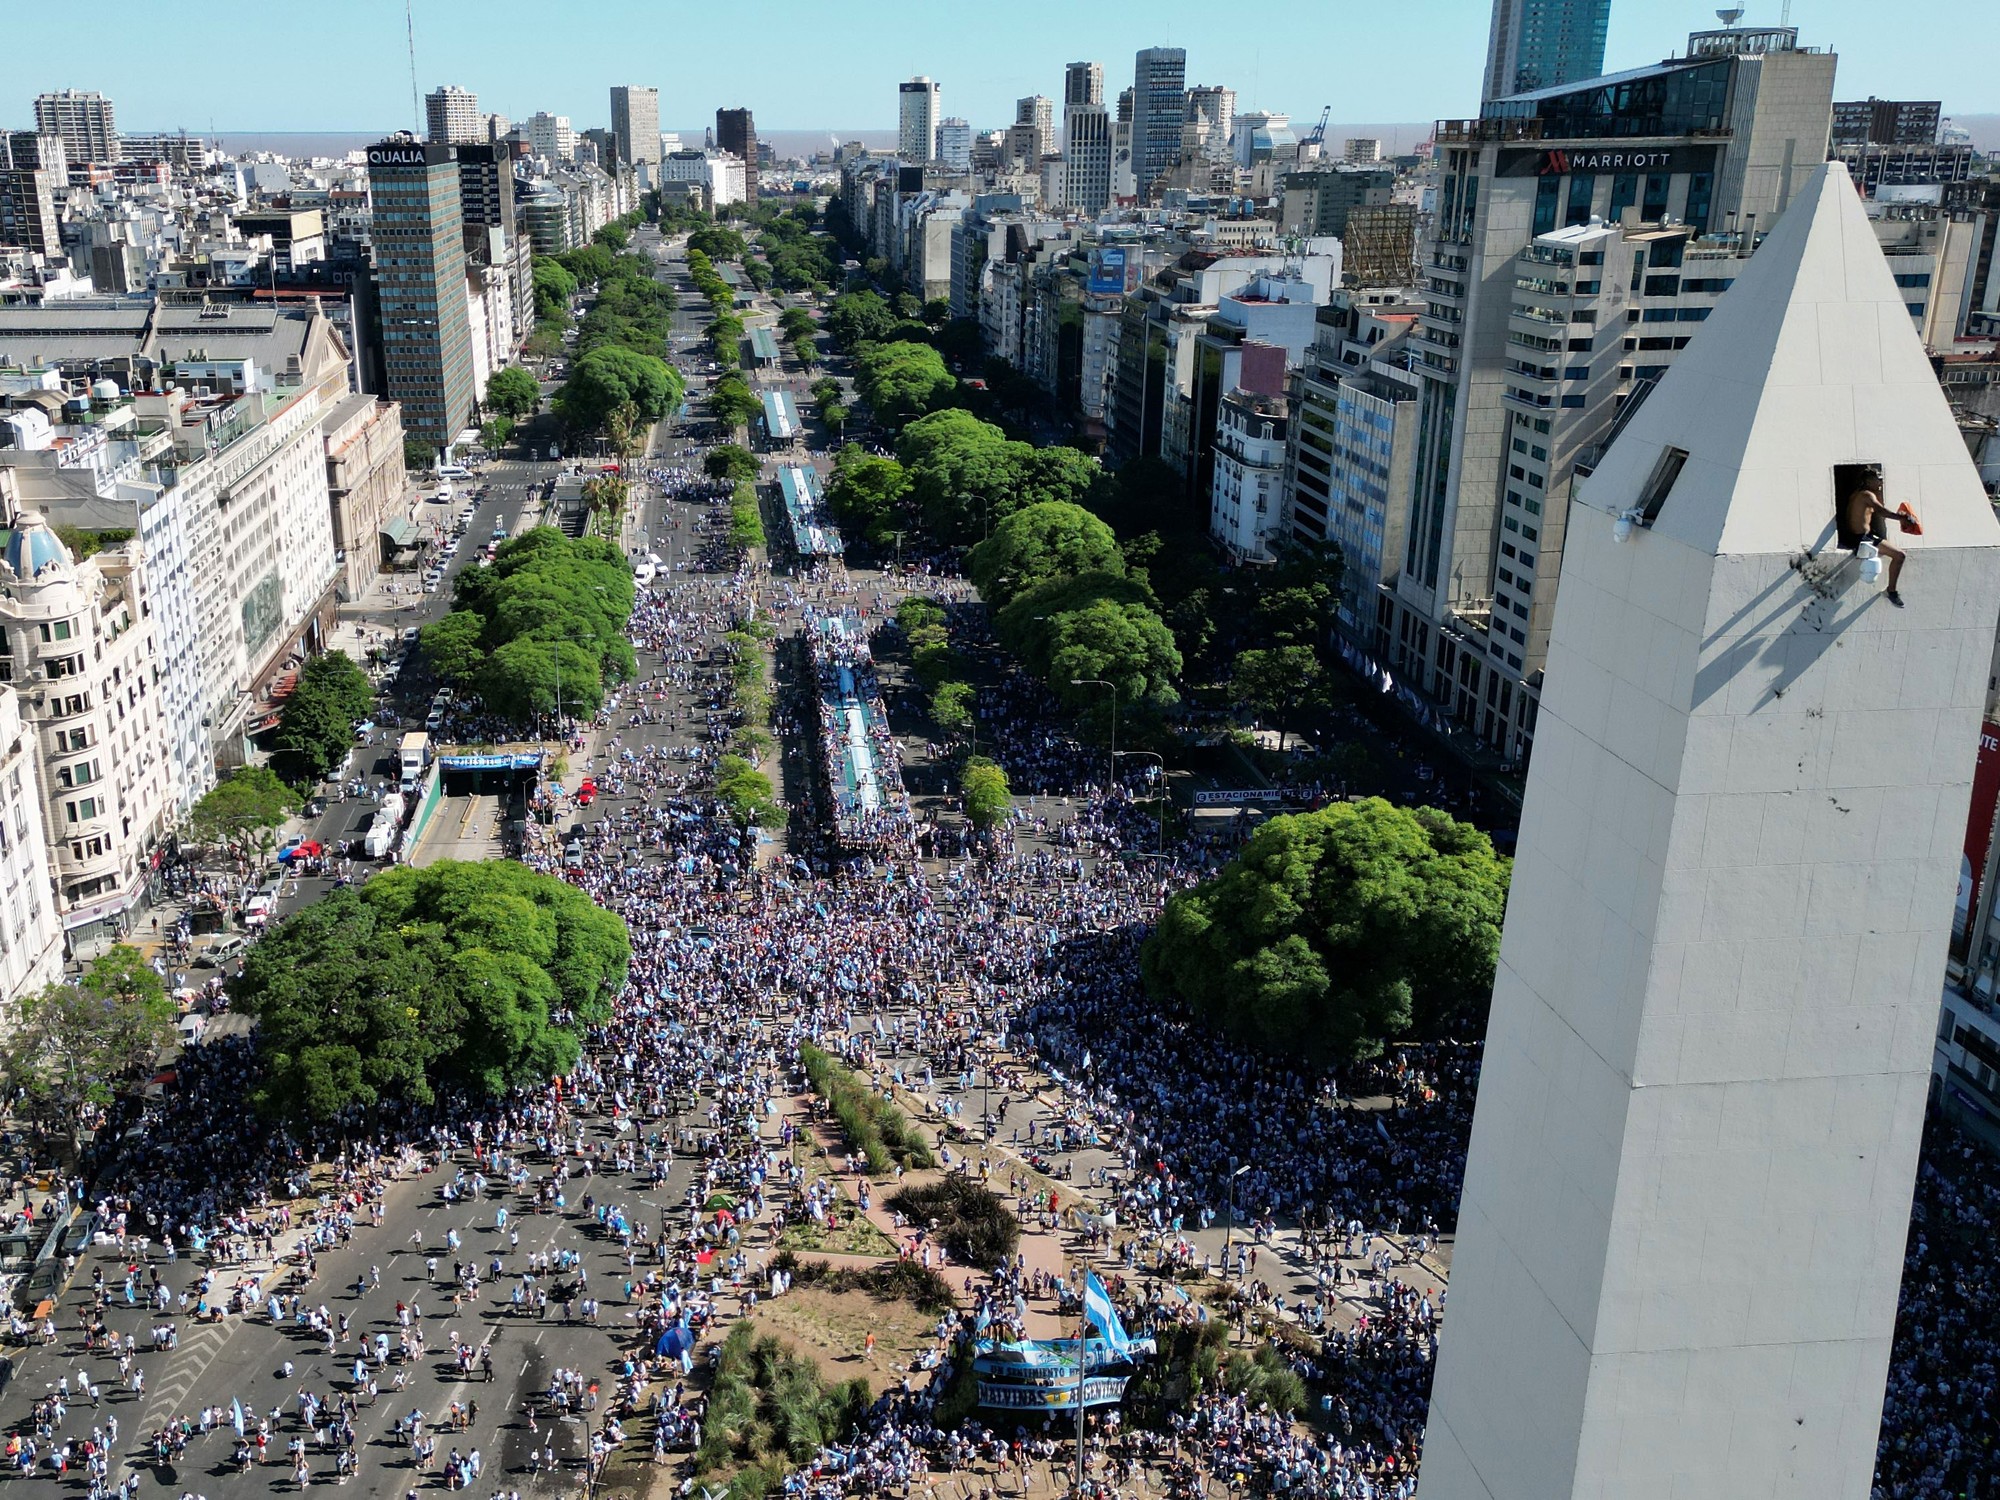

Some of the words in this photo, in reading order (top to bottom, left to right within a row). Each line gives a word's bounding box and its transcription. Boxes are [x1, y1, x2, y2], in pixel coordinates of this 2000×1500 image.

[369, 150, 425, 164] QUALIA
[1573, 153, 1670, 168] MARRIOTT
[1006, 1367, 1065, 1378] SENTIMIENTO
[978, 1384, 1047, 1406] MALVINAS
